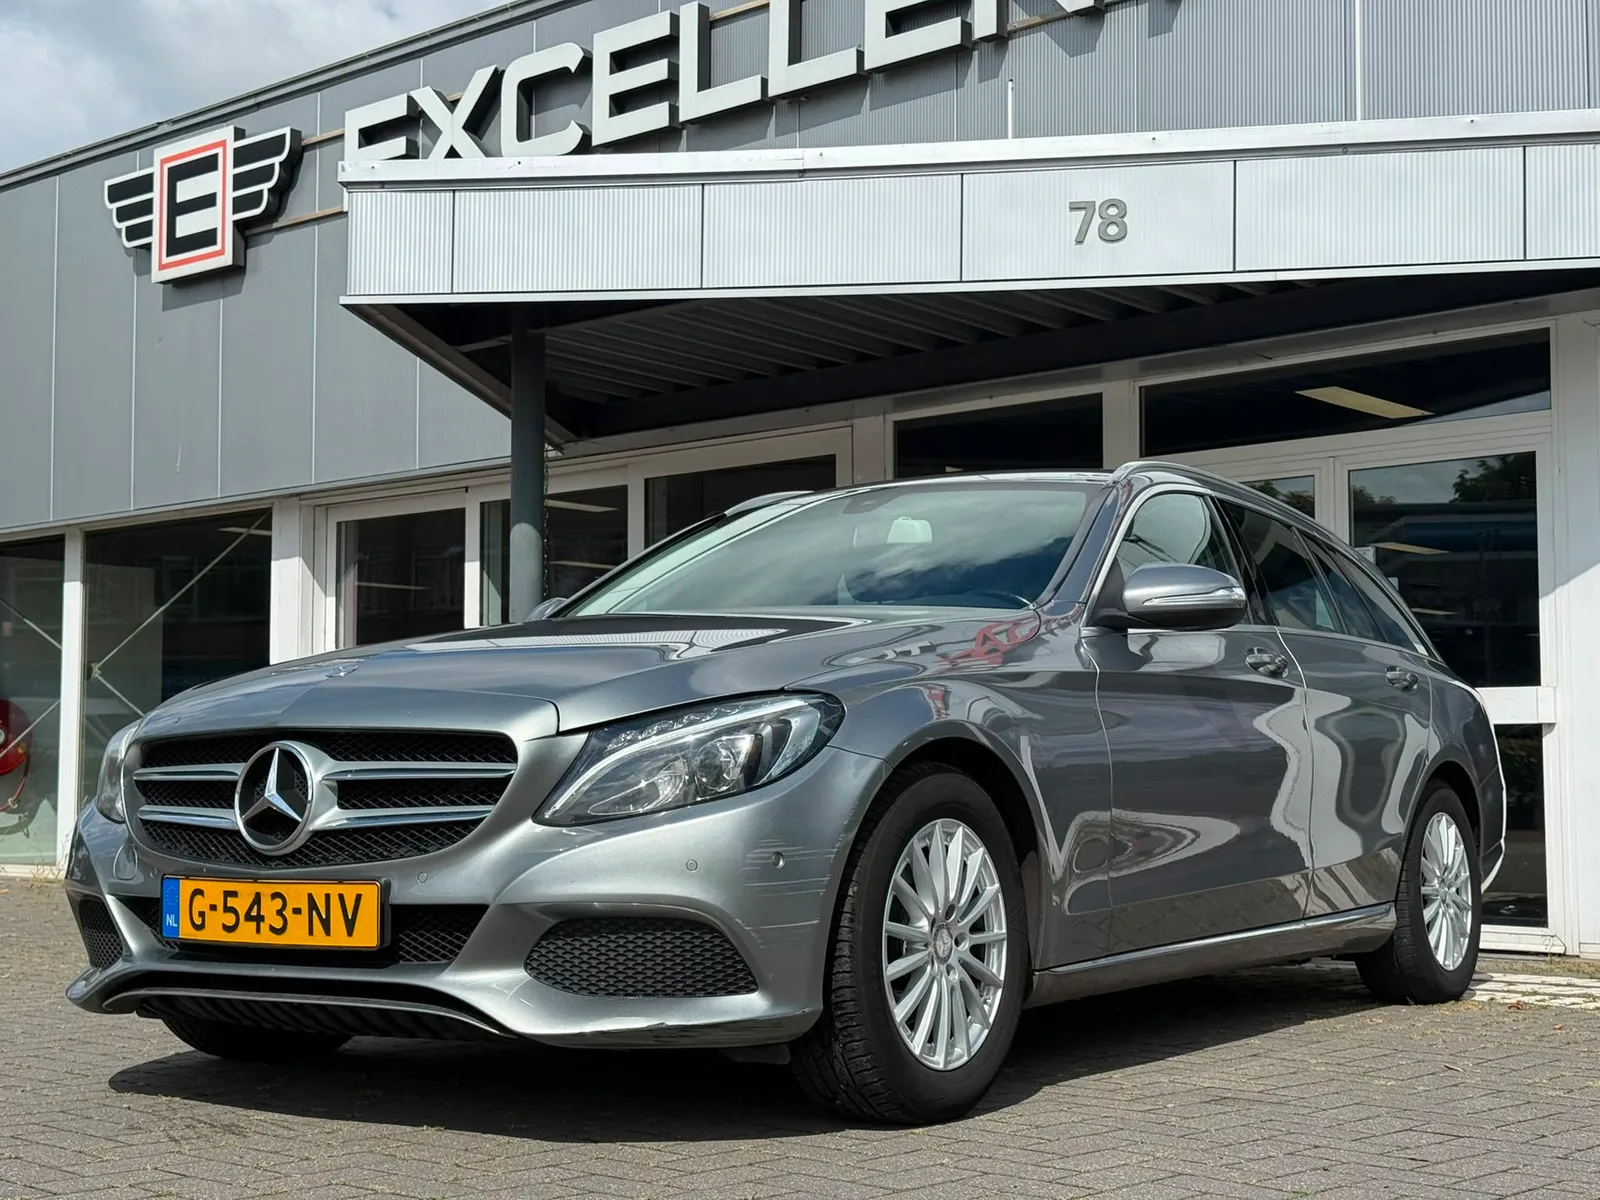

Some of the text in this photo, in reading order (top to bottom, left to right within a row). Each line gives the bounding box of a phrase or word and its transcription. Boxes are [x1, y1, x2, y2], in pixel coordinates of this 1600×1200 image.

[166, 152, 219, 258] E
[1068, 198, 1127, 245] 78
[165, 913, 178, 928] NL
[188, 887, 363, 938] G-543-NV
